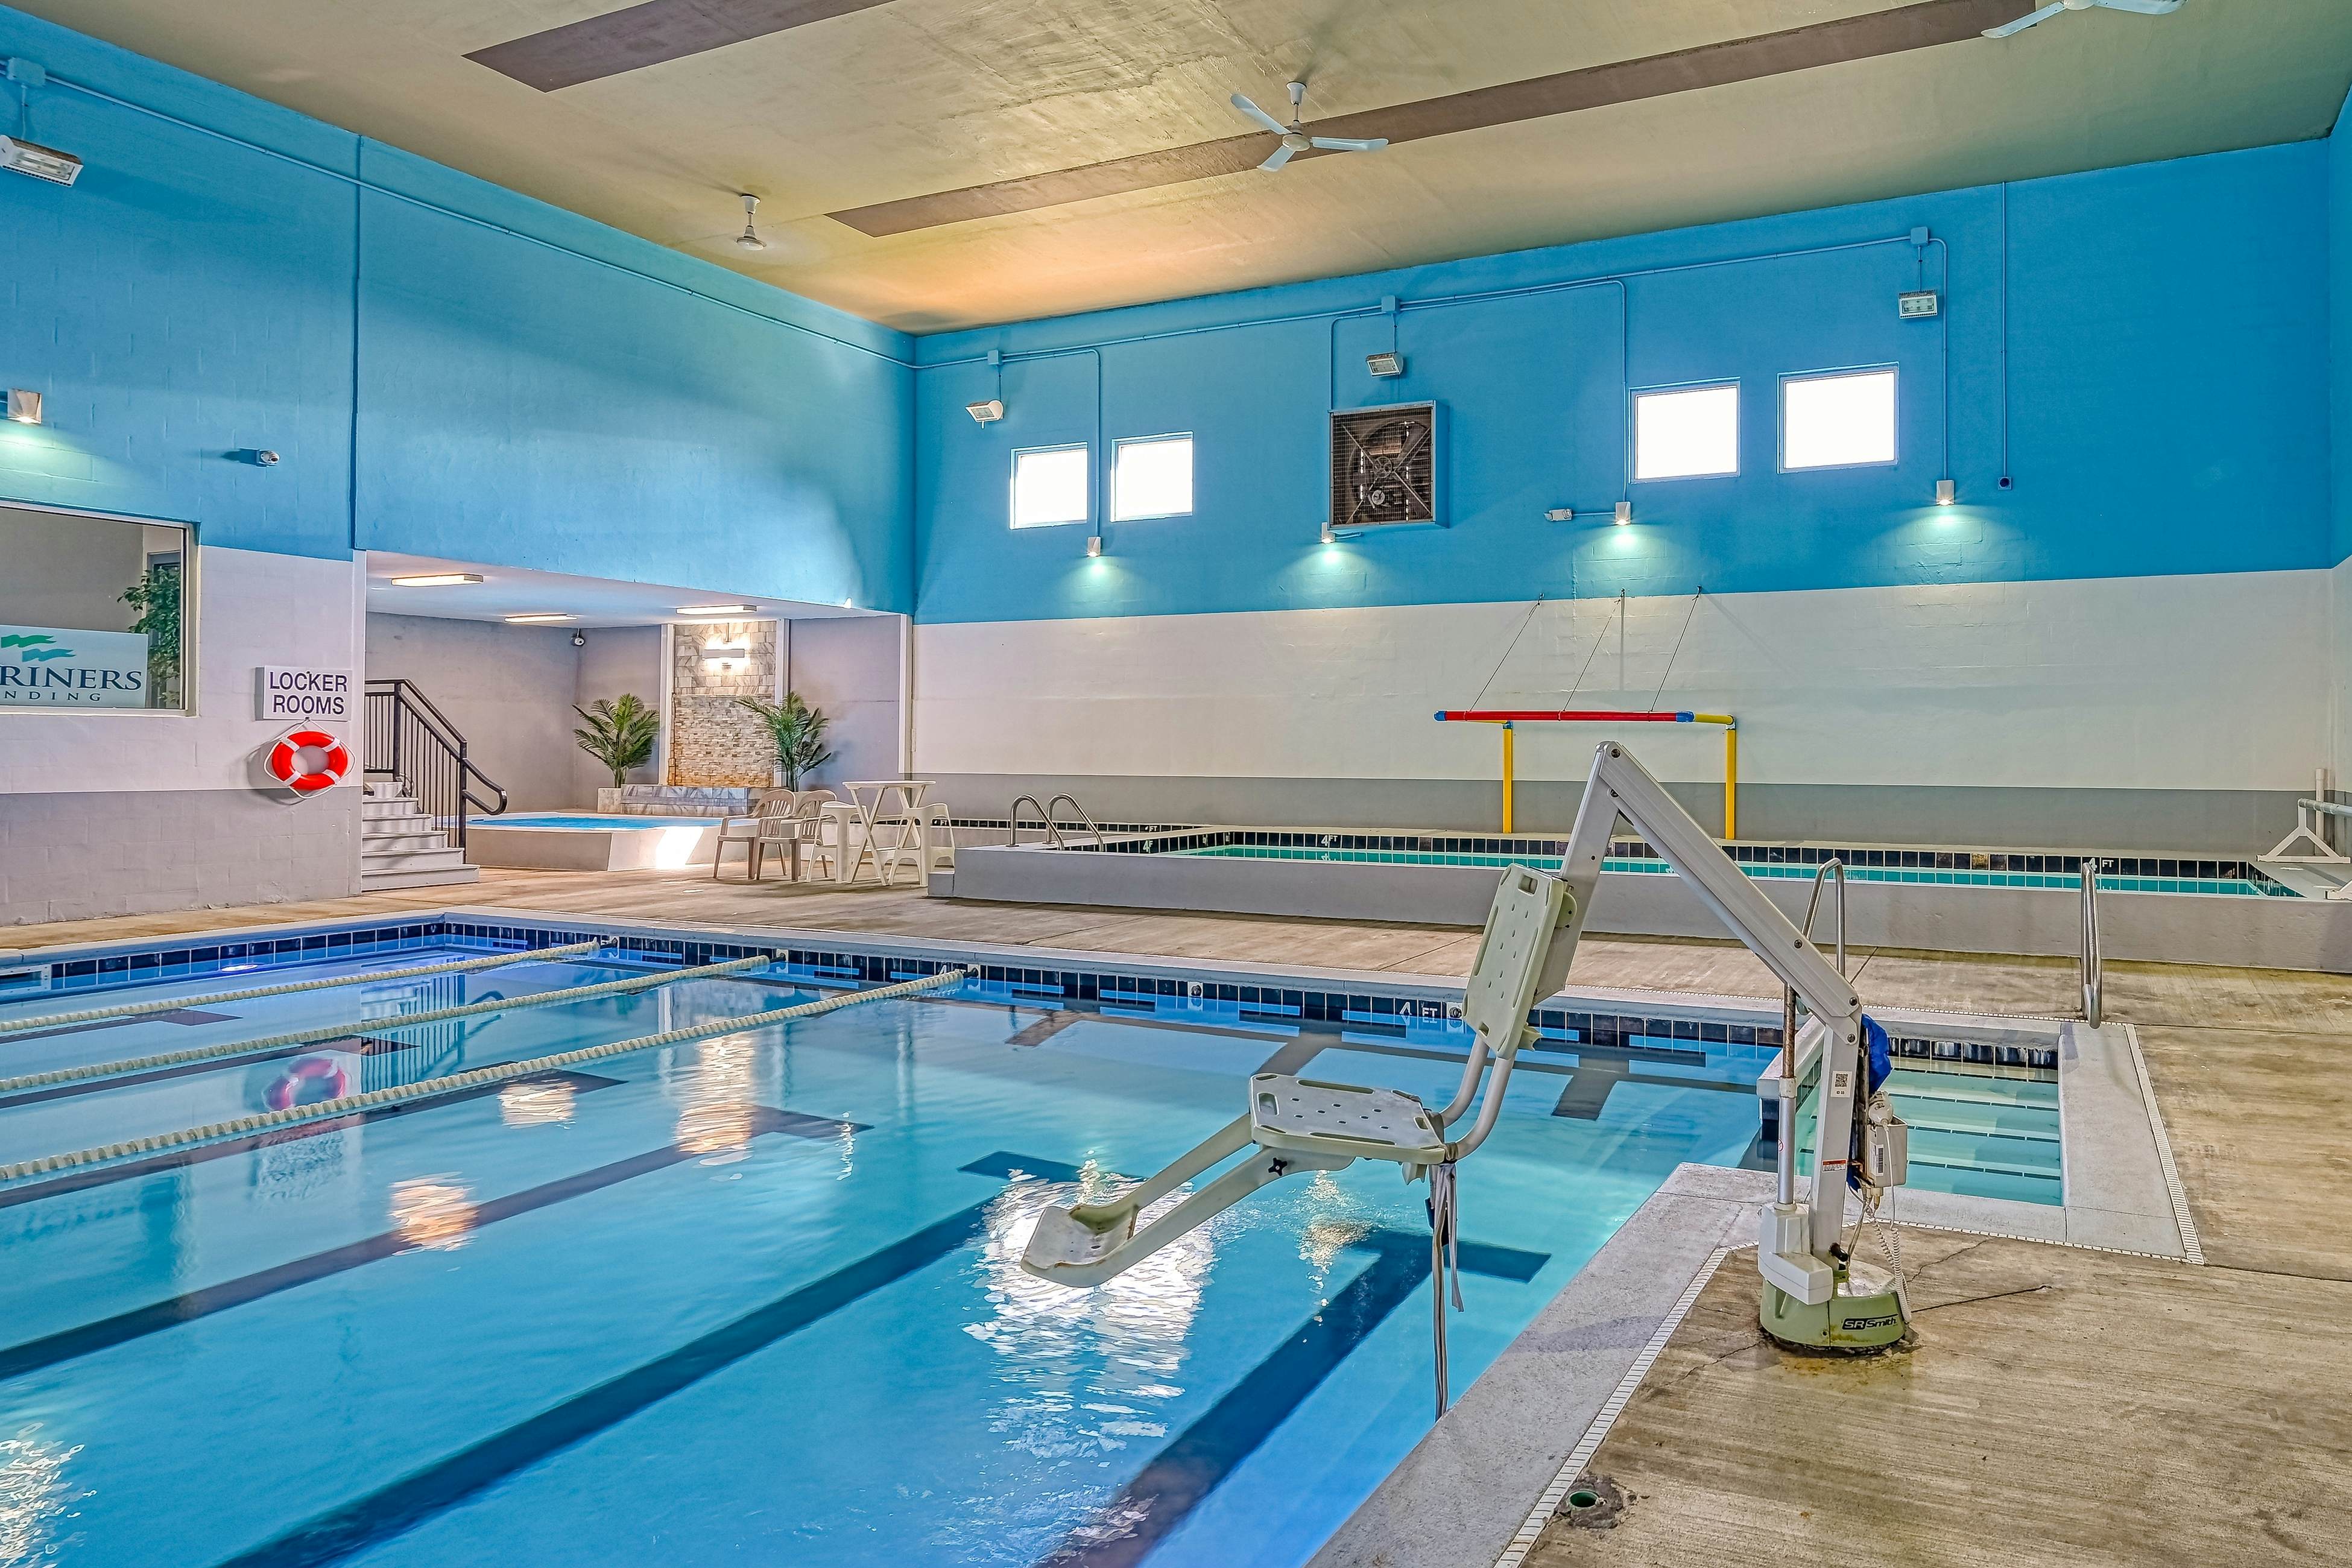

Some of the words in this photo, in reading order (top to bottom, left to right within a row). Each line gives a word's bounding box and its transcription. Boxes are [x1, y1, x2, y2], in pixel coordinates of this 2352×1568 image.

[0, 665, 142, 690] RINERS
[270, 671, 347, 692] LOCKER
[5, 691, 101, 701] NDING
[273, 694, 344, 715] ROOMS
[1422, 1007, 1438, 1017] FT
[1866, 1317, 1897, 1328] Smith
